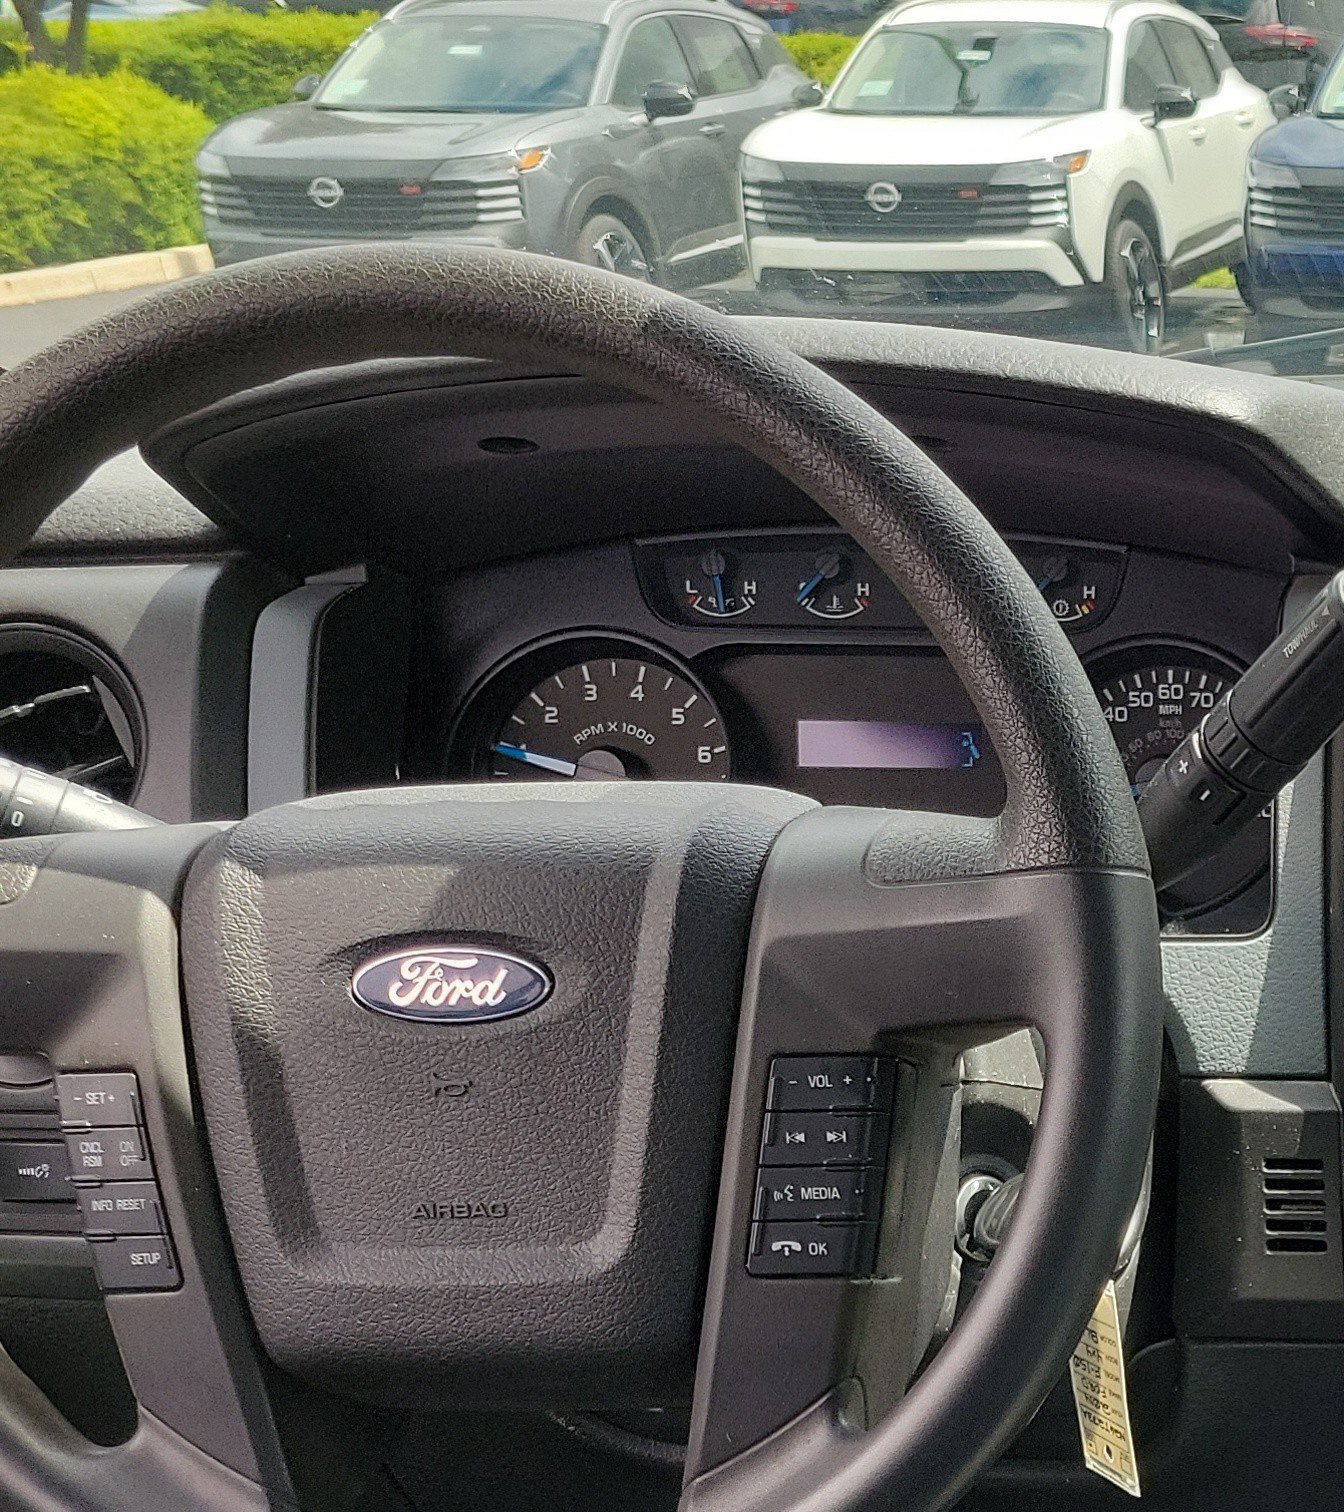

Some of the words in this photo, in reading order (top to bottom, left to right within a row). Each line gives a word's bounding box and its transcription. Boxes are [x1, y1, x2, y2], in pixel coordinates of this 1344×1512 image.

[686, 579, 698, 593] L
[744, 580, 757, 595] H
[857, 582, 870, 597] H
[1083, 586, 1096, 598] H
[584, 684, 597, 701] 3
[630, 684, 644, 701] 4
[1128, 692, 1154, 707] 50
[1158, 684, 1184, 700] 60
[1190, 692, 1214, 708] 70
[544, 706, 558, 723] 2
[671, 708, 685, 725] 5
[1102, 706, 1128, 722] 40
[1158, 704, 1182, 715] MPH
[573, 723, 604, 745] RPM
[607, 721, 618, 732] X
[622, 722, 656, 745] 1000
[697, 746, 711, 763] 6
[387, 954, 510, 1008] Ford
[807, 1074, 833, 1089] VOL
[85, 1092, 106, 1105] SET
[800, 1185, 841, 1202] MEDIA
[91, 1199, 113, 1211] INFO
[116, 1199, 147, 1210] RESET
[411, 1201, 510, 1219] AIRBAG
[808, 1241, 828, 1256] OK
[130, 1252, 161, 1266] SETUP
